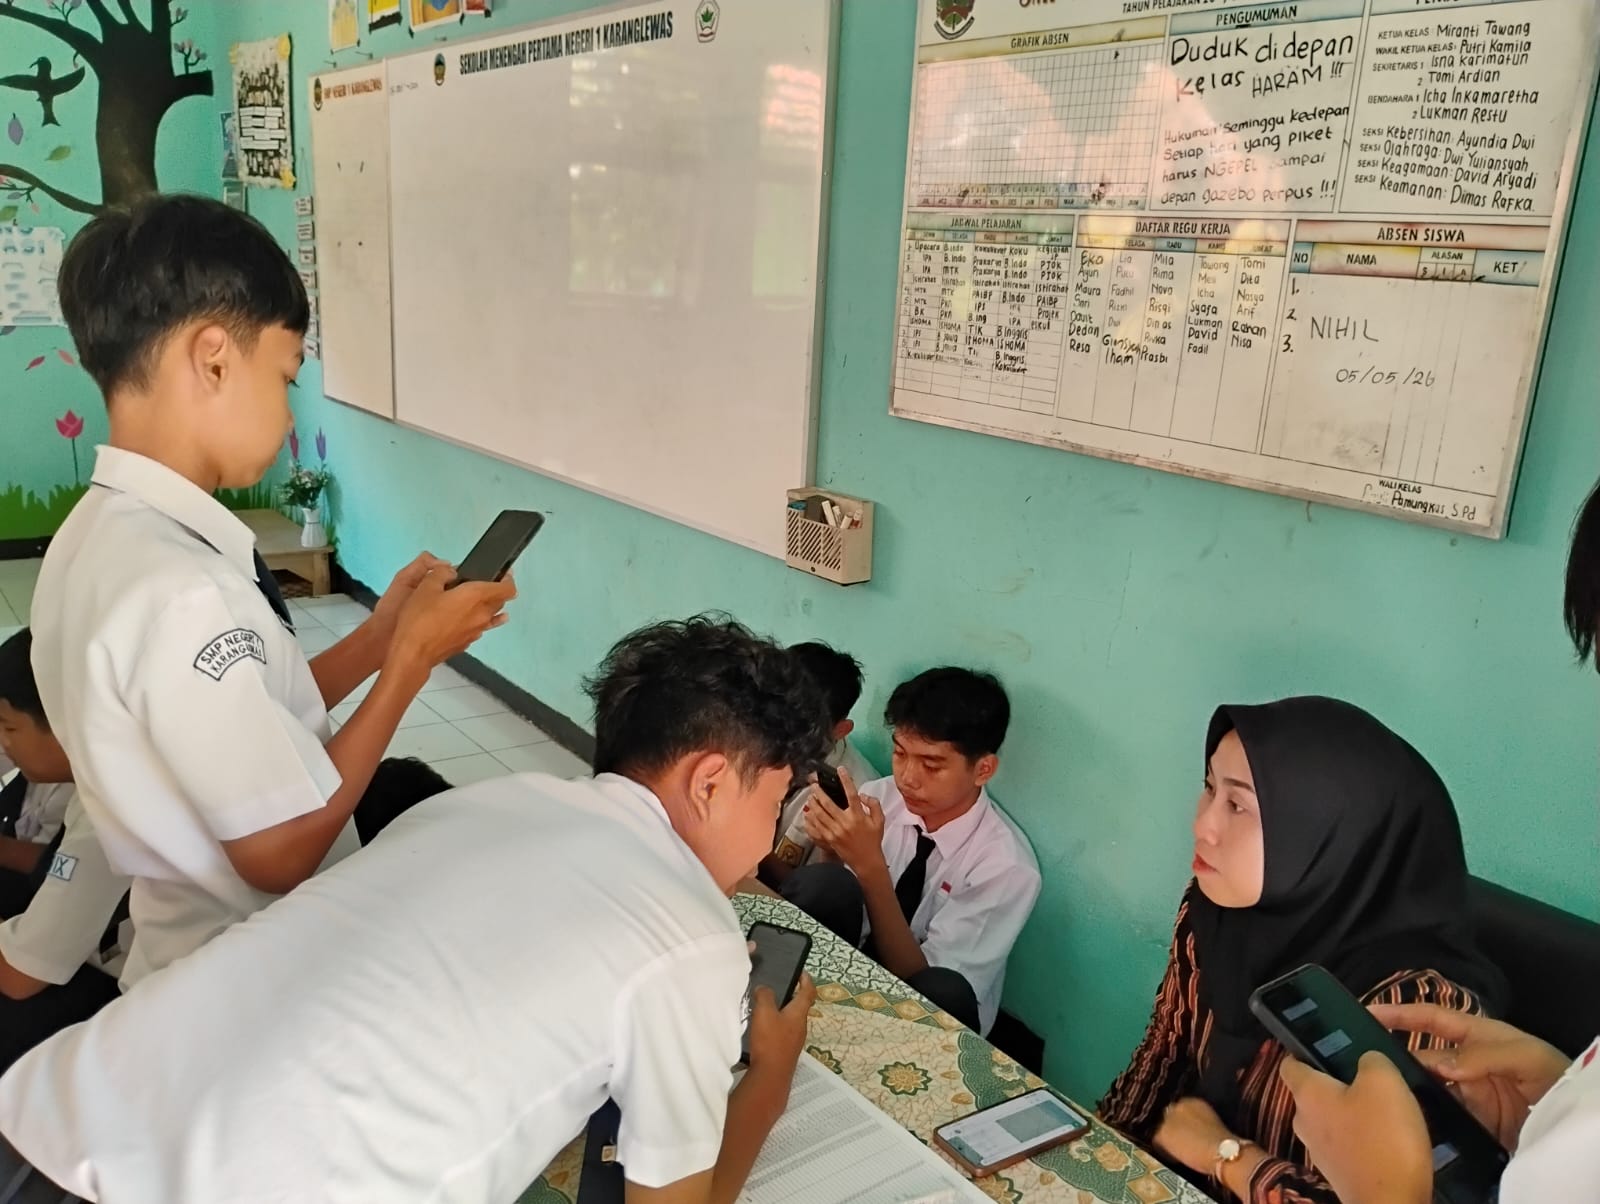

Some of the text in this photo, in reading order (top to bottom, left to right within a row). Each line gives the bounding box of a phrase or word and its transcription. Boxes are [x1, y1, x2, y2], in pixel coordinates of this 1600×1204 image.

[1122, 0, 1150, 14] TAHUN
[1216, 5, 1298, 26] PENGUMUMAN
[528, 33, 563, 63] PERTAMA
[565, 26, 594, 57] NEGERI
[596, 26, 601, 50] 1
[603, 10, 673, 49] KARANGLEWAS
[1378, 29, 1403, 40] KETUA
[1437, 24, 1479, 38] Miranti
[1485, 20, 1530, 37] Tawang
[1010, 33, 1069, 50] GRAFIK ABSEN
[1460, 39, 1531, 54] Putri Kamila
[1171, 35, 1249, 66] Duduk
[1375, 46, 1399, 55] WAKIL
[1400, 44, 1426, 54] KETUA
[1372, 61, 1418, 72] SEKRETARIS
[1431, 54, 1455, 68] Isna
[1252, 64, 1321, 98] HARAM
[1428, 69, 1500, 84] Tomi Ardian
[1423, 88, 1447, 104] Icha
[1420, 105, 1508, 124] Lukman Restu
[1244, 134, 1281, 153] yang
[1288, 126, 1333, 145] piket
[1362, 128, 1383, 137] SEKSI
[1359, 143, 1380, 152] SEKSI
[1456, 130, 1507, 151] Ayundia
[1512, 133, 1536, 149] Dwi
[1357, 159, 1378, 168] SEKSI
[1443, 147, 1463, 165] Dwi
[1468, 150, 1528, 175] Yuliansyah
[1354, 175, 1376, 184] SEKSI
[1454, 167, 1489, 185] David
[1493, 171, 1539, 190] Aryadi
[1202, 188, 1256, 204] gazebo
[1450, 184, 1486, 208] Dimas
[981, 218, 1022, 229] PELAJARAN
[1135, 221, 1231, 235] DAFTAR REGU KERJA
[1377, 227, 1465, 242] ABSEN SISWA
[1081, 250, 1104, 266] Eko
[1153, 253, 1174, 266] Mila
[1294, 252, 1308, 264] NO
[1346, 254, 1377, 265] NAMA
[1432, 250, 1463, 260] ALASAN
[1240, 257, 1266, 269] Tomi
[1493, 261, 1518, 274] KET
[1152, 266, 1174, 280] Rima
[1075, 282, 1101, 296] Maura
[1236, 304, 1256, 318] Arif
[1286, 308, 1297, 320] 2.
[1187, 316, 1222, 329] Lukman
[1310, 316, 1379, 342] NIHIL
[1187, 327, 1218, 341] David
[1187, 342, 1209, 355] Fadil
[1231, 334, 1252, 349] Nisa
[1282, 334, 1294, 353] 3.
[1379, 480, 1397, 490] WALI
[1398, 482, 1422, 494] KELAS
[200, 642, 222, 665] SMP
[53, 856, 69, 876] IX
